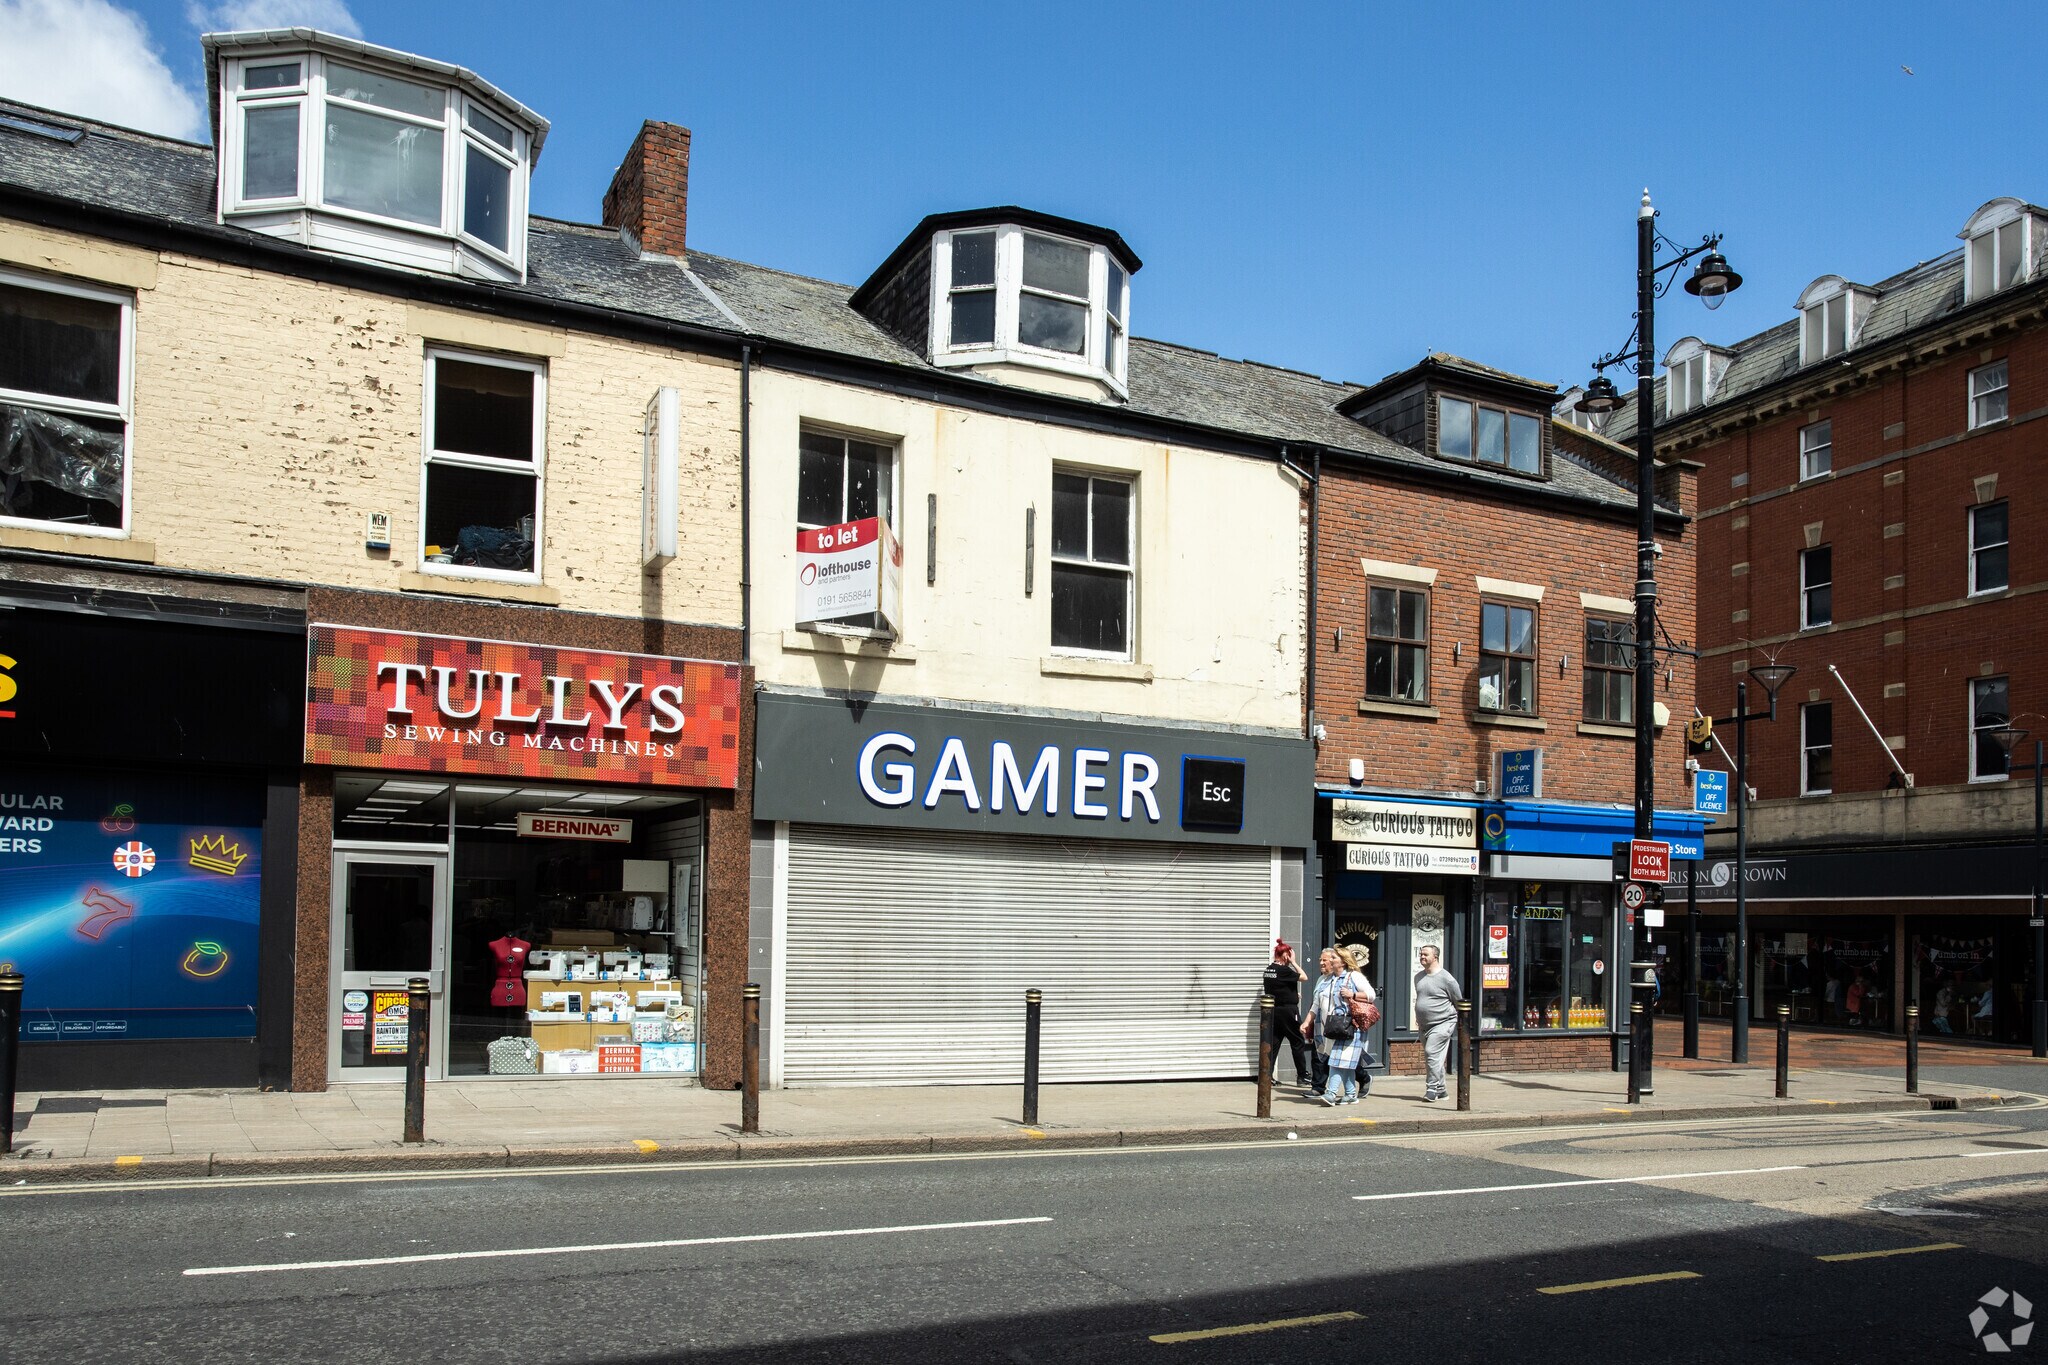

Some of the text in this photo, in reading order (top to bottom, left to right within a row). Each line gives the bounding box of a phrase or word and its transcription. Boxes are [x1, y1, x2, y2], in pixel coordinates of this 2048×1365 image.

[372, 513, 387, 526] WEM
[818, 526, 858, 549] to let
[818, 559, 871, 577] lofthouse
[818, 573, 851, 585] and partners
[818, 589, 872, 606] 0191 5658844
[377, 661, 685, 734] TULLYS
[384, 723, 676, 758] SEWING MACHINES
[857, 731, 1161, 821] GAMER
[1512, 776, 1524, 784] OFF
[1202, 780, 1231, 803] Esc
[1506, 785, 1530, 794] LICENCE
[1705, 793, 1717, 801] OFF
[1700, 801, 1722, 810] LICENCE
[0, 816, 53, 831] ARD
[532, 819, 612, 836] BERNINA
[1373, 809, 1473, 839] CURIOUS TATTOO
[1633, 845, 1667, 854] PEDESTRIANS
[1675, 844, 1697, 855] Store
[1349, 848, 1390, 867] CURIOUS
[1393, 851, 1429, 868] TATTOO
[1638, 855, 1662, 866] LOOK
[1633, 868, 1666, 877] BOTH WAYS
[1715, 866, 1726, 883] &
[1626, 890, 1642, 901] 20
[1413, 898, 1442, 911] CURIOUS
[1335, 921, 1379, 940] CURIOUS
[1484, 966, 1508, 974] UNDER
[1484, 973, 1507, 981] NEW
[376, 997, 409, 1013] CIRCUS
